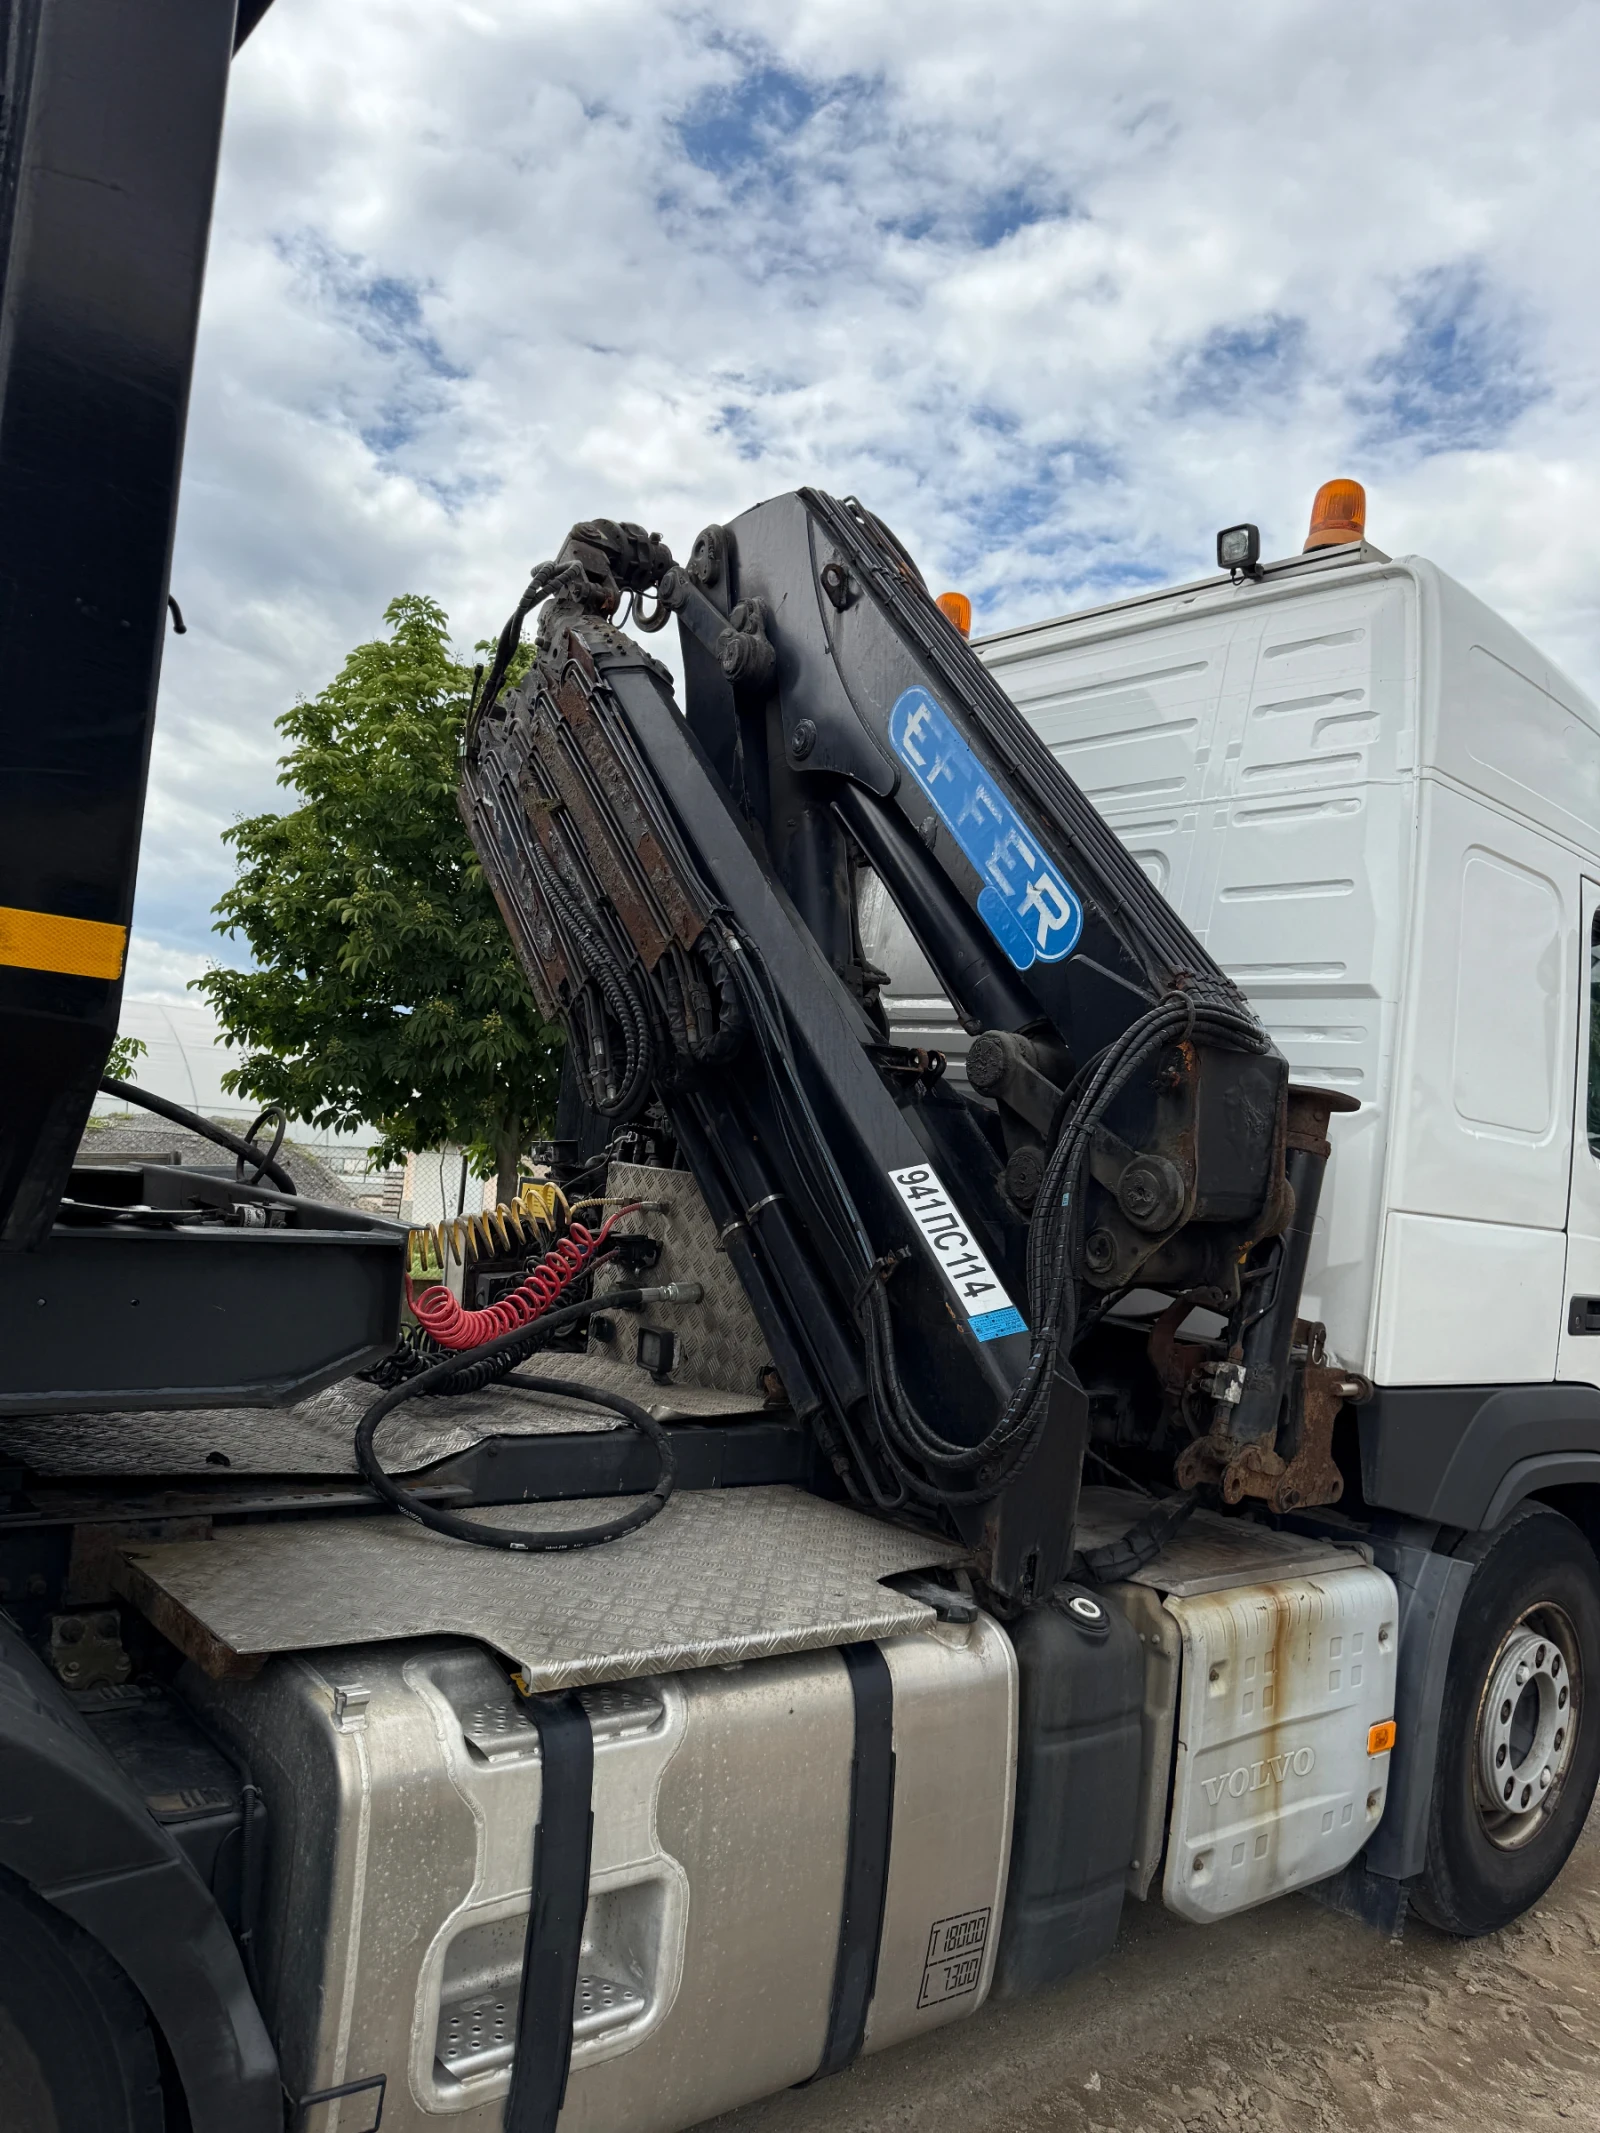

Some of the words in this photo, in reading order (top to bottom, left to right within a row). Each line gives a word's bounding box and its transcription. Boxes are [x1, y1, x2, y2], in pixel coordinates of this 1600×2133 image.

[901, 702, 1071, 950] EFFER
[1201, 1747, 1315, 1806] VOLVO
[931, 1930, 941, 1956] T
[944, 1917, 986, 1952] 18000
[923, 1973, 930, 1999] L
[944, 1958, 979, 1991] 7300
